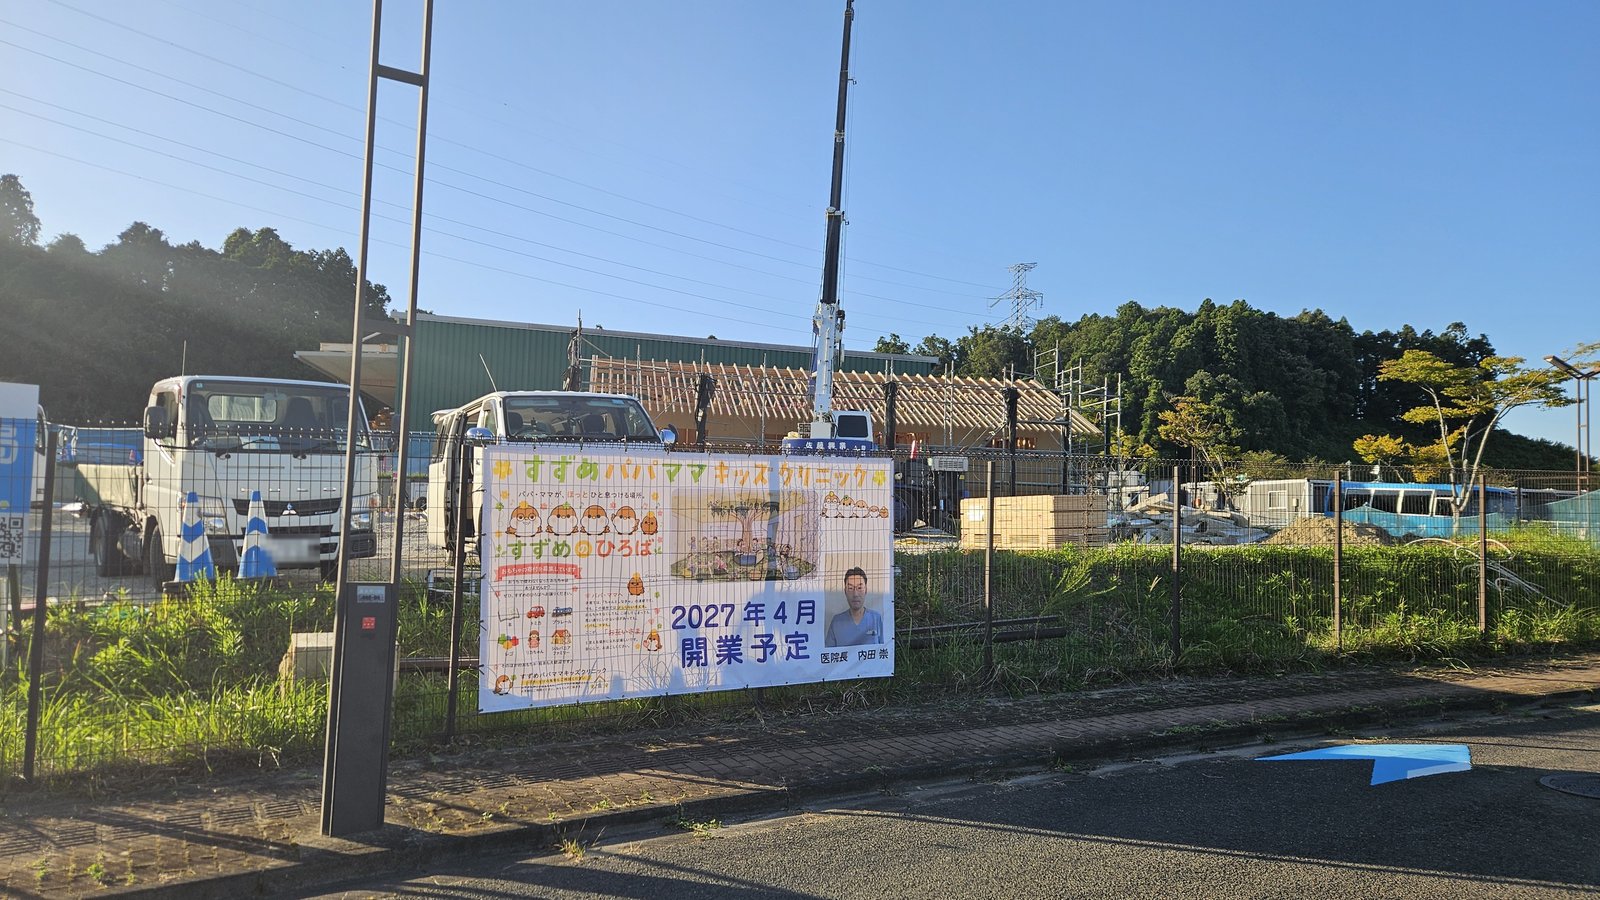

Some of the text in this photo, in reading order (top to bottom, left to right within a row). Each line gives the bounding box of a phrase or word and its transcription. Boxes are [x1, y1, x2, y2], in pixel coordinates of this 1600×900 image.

[507, 538, 655, 561] すずめのひろば
[681, 630, 810, 668] 開業予定
[820, 651, 849, 664] 医院長
